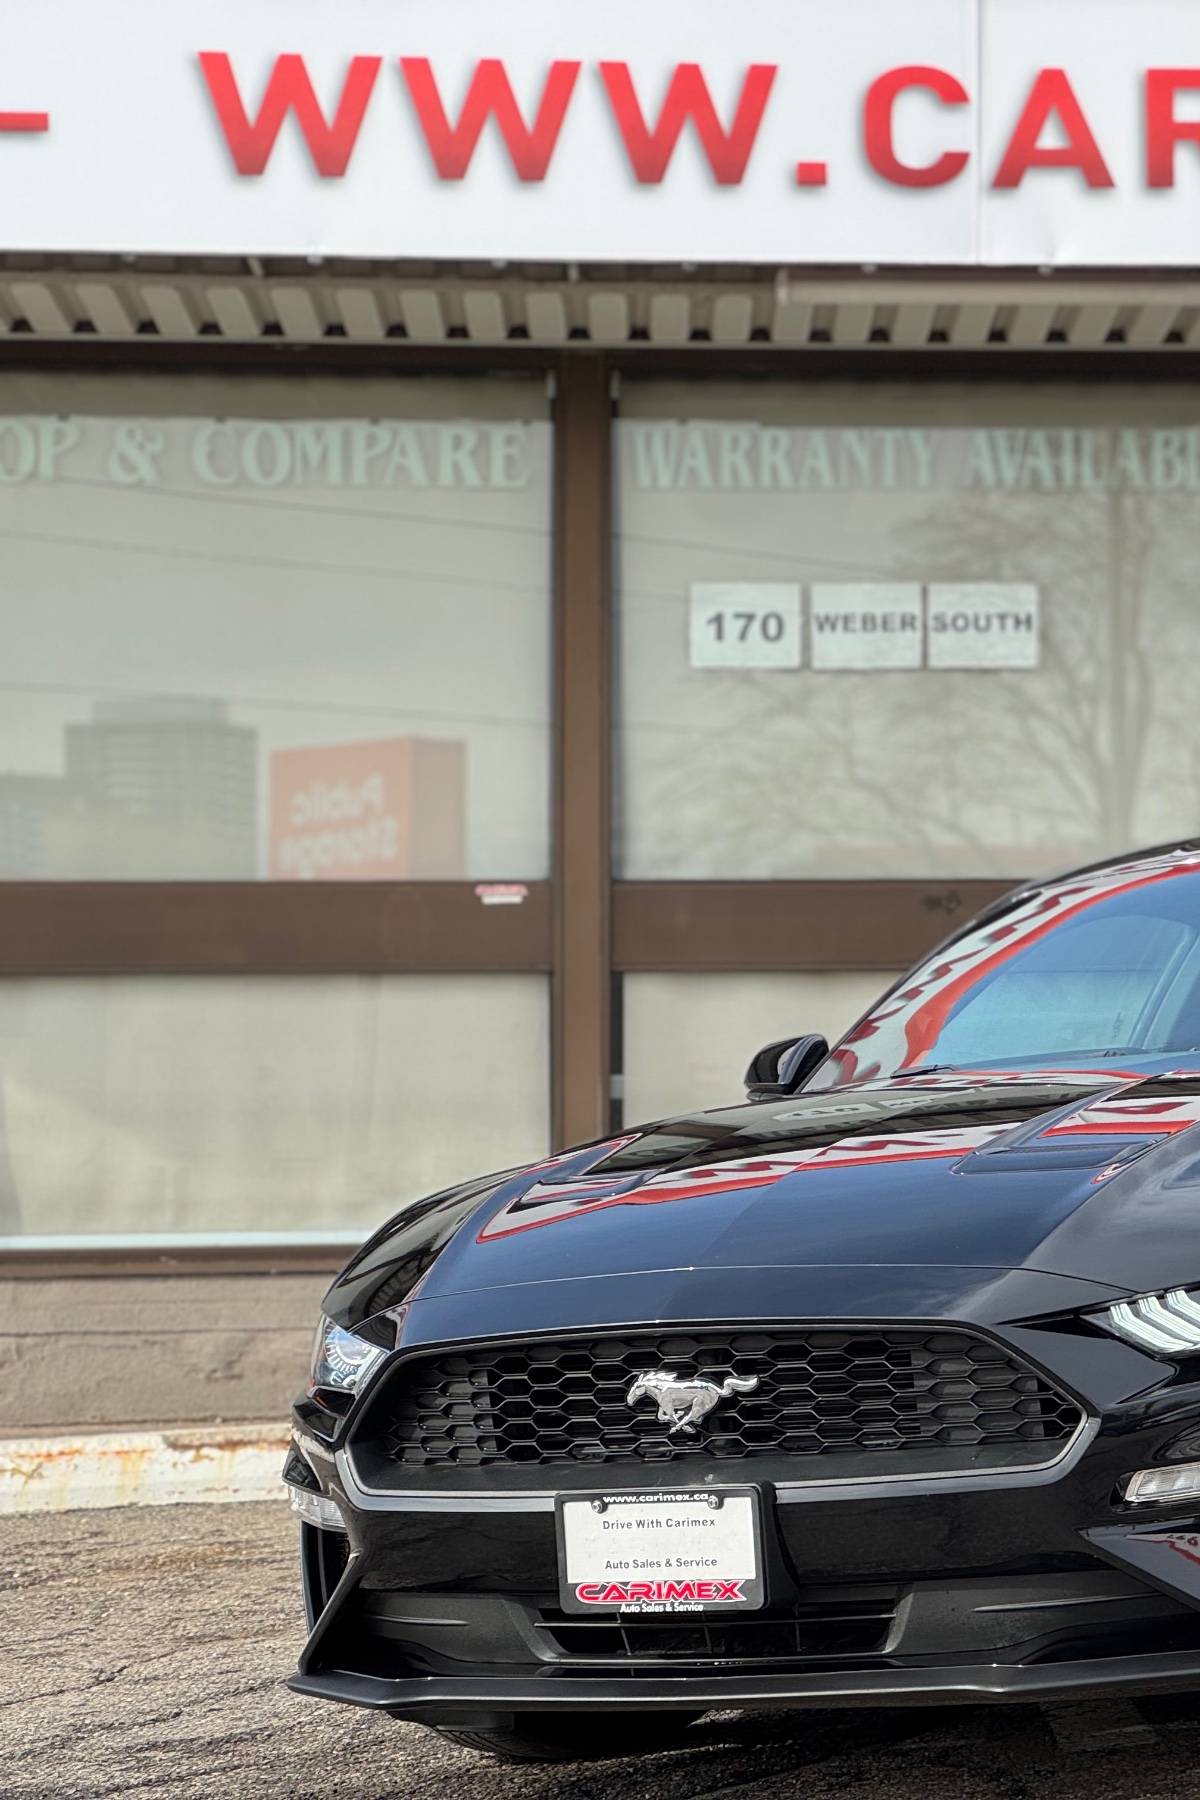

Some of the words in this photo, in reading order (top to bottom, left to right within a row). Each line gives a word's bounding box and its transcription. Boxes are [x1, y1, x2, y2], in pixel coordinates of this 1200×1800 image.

[107, 424, 166, 485] &
[191, 423, 530, 488] COMPARE
[634, 428, 938, 489] WARRANTY
[705, 612, 785, 643] 170
[814, 612, 918, 634] WEBER
[932, 612, 1035, 634] SOUTH
[602, 1493, 709, 1504] www.carimex.ca
[602, 1520, 633, 1530] Drive
[636, 1518, 662, 1529] With
[665, 1517, 716, 1528] Carimex
[604, 1560, 630, 1570] Auto
[632, 1558, 662, 1569] Sales
[664, 1558, 673, 1568] &
[675, 1556, 718, 1567] Service
[576, 1580, 747, 1604] CARIMEX
[619, 1603, 640, 1613] Auto
[641, 1602, 664, 1613] Sales
[665, 1602, 673, 1612] &
[673, 1601, 704, 1612] Service
